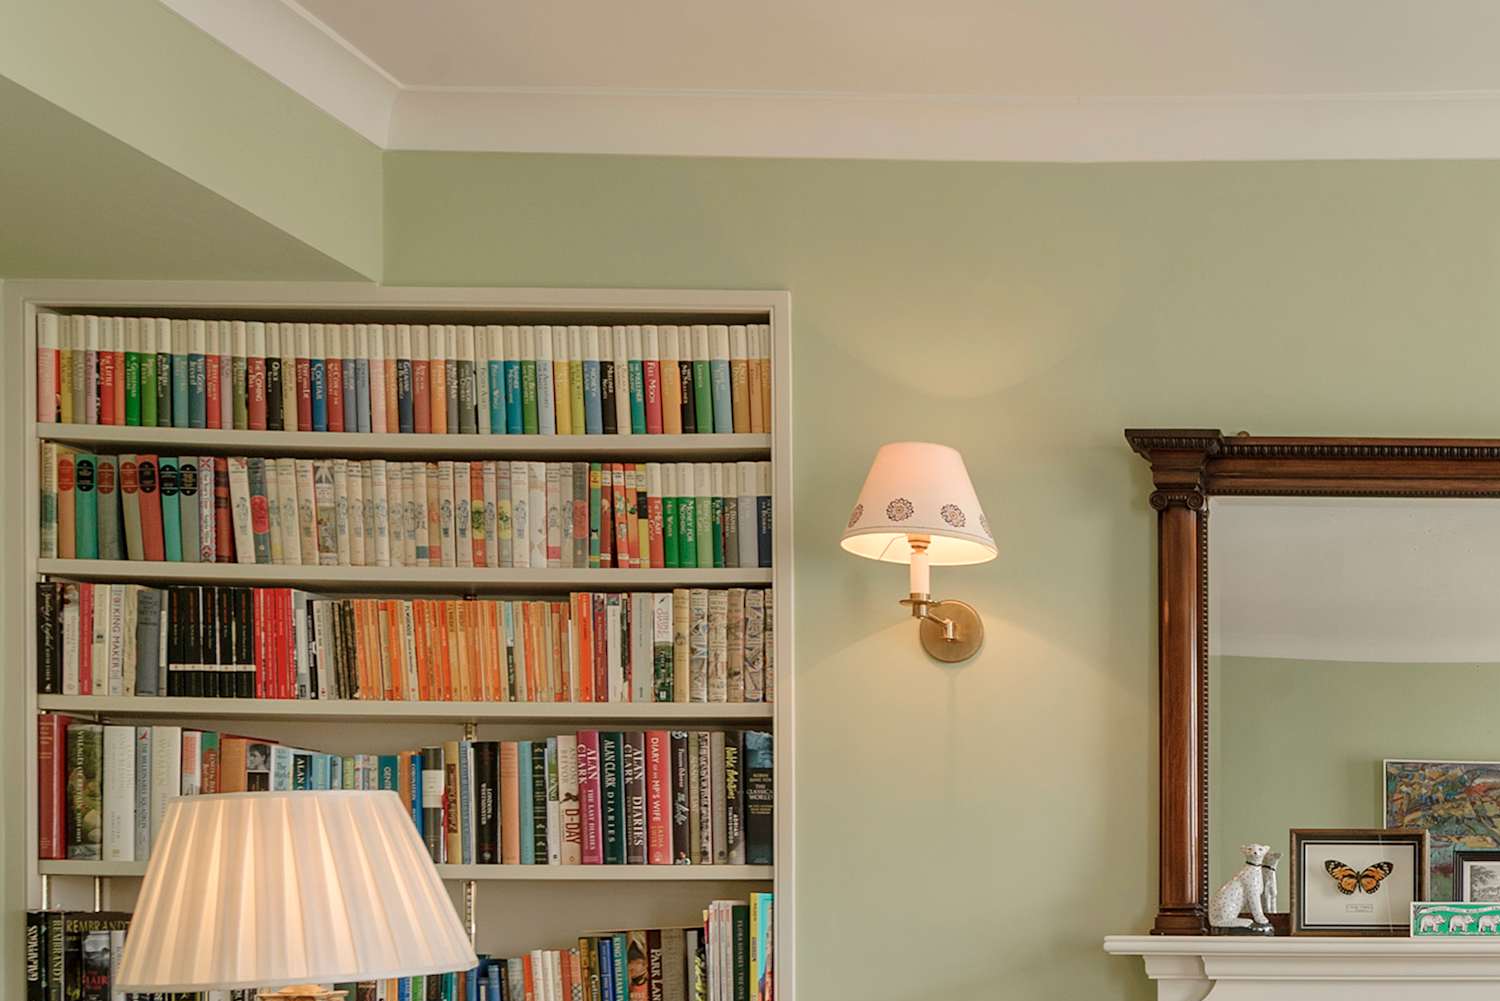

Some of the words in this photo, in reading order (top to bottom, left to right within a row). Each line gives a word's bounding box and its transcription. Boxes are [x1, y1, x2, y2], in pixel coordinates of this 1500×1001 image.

[648, 378, 657, 403] MOON
[112, 608, 121, 633] KING
[577, 744, 588, 784] CLARK
[588, 748, 598, 781] ALAN
[604, 739, 615, 762] ALAN
[623, 744, 634, 784] CLARK
[633, 748, 643, 781] ALAN
[651, 737, 660, 764] DIARY
[296, 758, 306, 785] ALAN
[605, 762, 617, 788] CLARK
[565, 808, 582, 845] D-DAY
[607, 791, 615, 843] DIARIES
[632, 796, 644, 846] DIARIES
[653, 800, 662, 822] WIFE
[67, 919, 131, 932] REMBRANDT
[27, 924, 40, 982] GALAPAGOS
[51, 919, 63, 984] REMBRANDT
[613, 937, 623, 957] KING
[650, 948, 661, 977] PARK
[614, 958, 624, 994] WILLIAM
